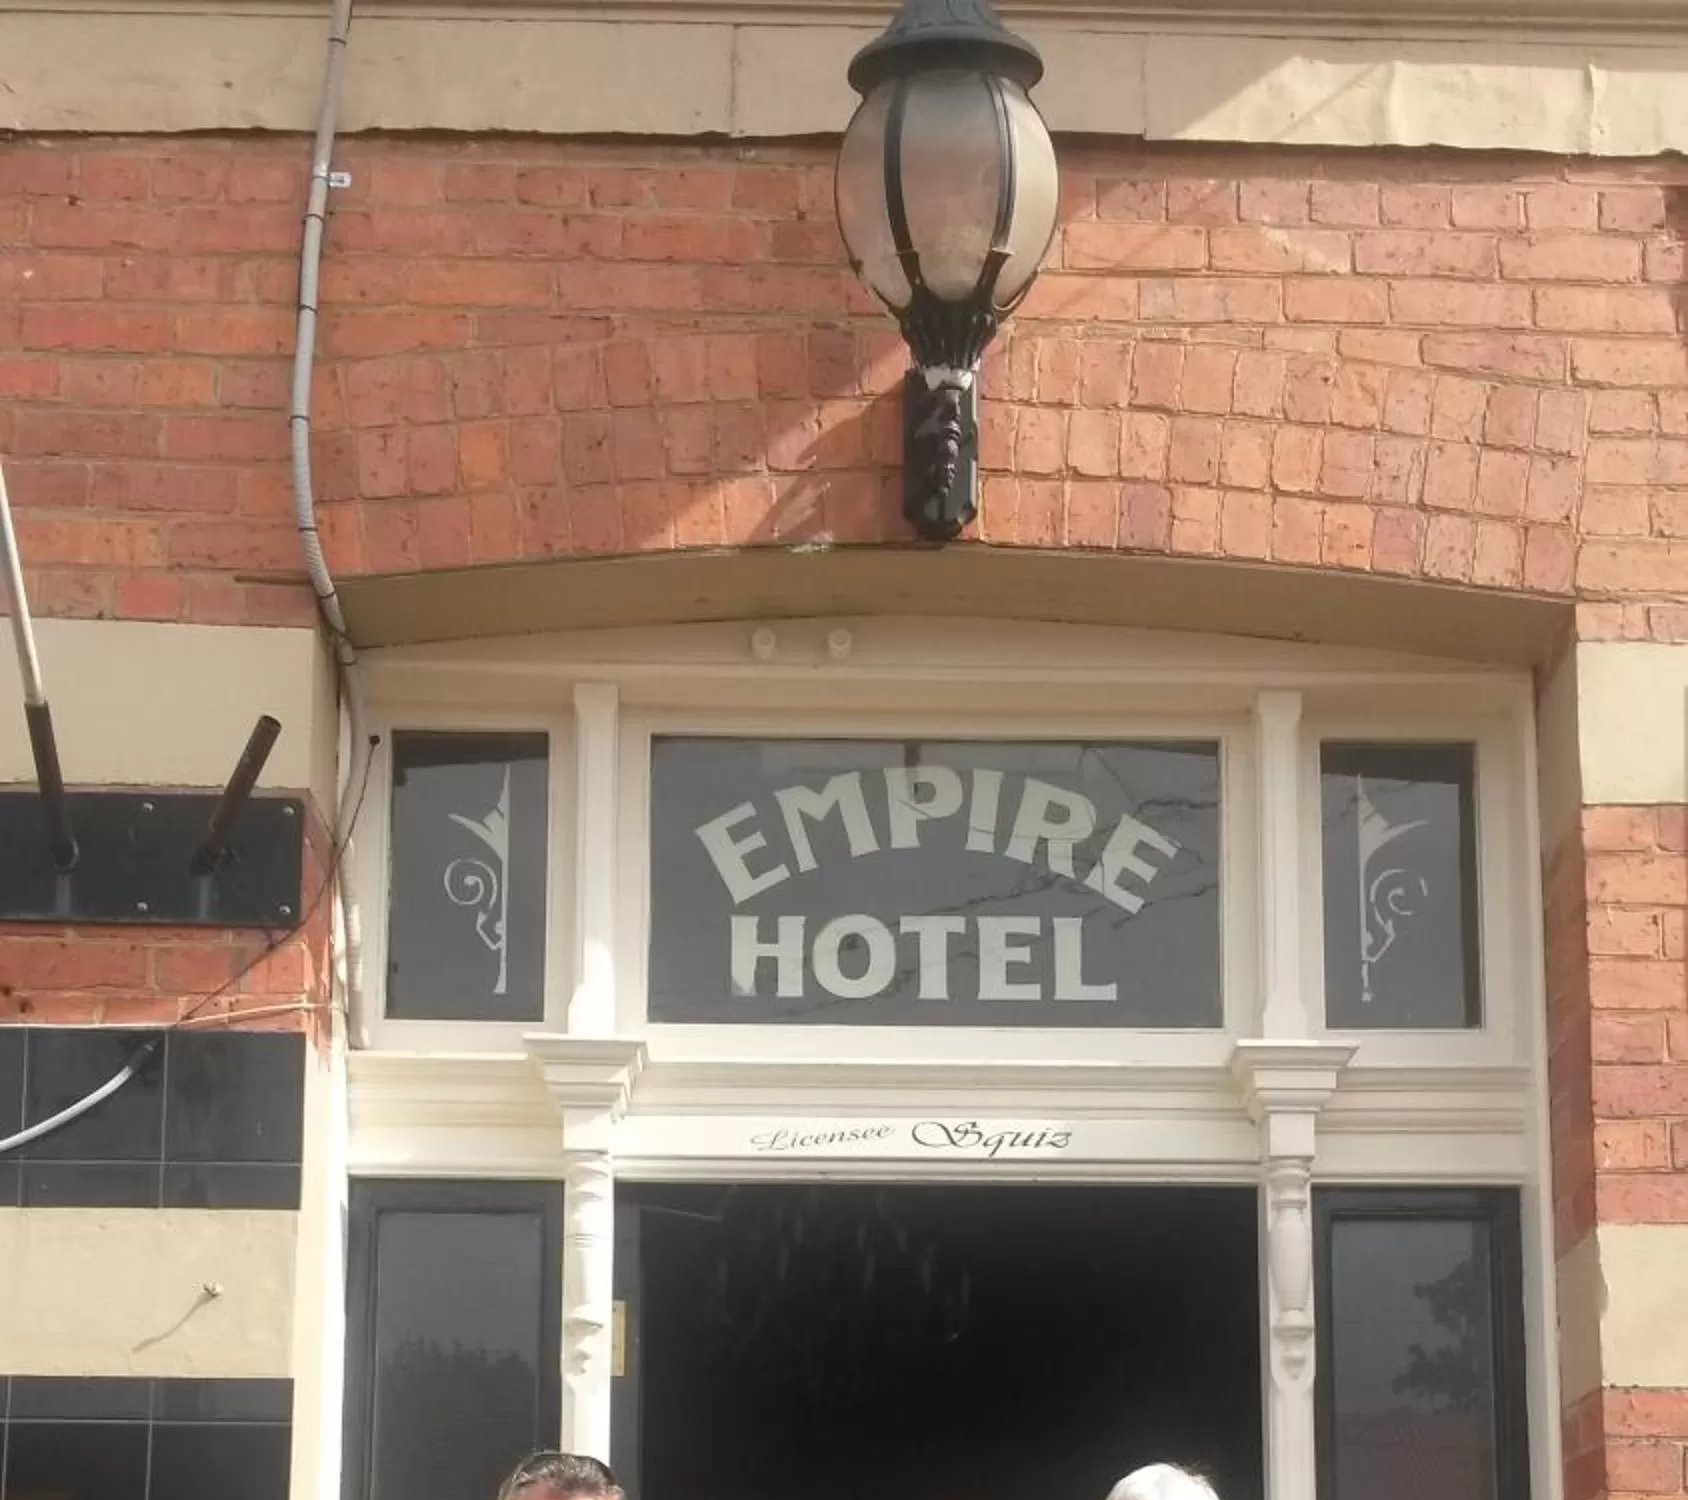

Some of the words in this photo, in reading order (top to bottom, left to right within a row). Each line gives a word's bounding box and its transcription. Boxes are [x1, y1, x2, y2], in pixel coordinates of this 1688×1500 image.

[695, 765, 1182, 914] EMPIRE
[729, 913, 1118, 1001] HOTEL
[750, 1123, 894, 1152] Licensee
[911, 1119, 1073, 1158] Squiz
